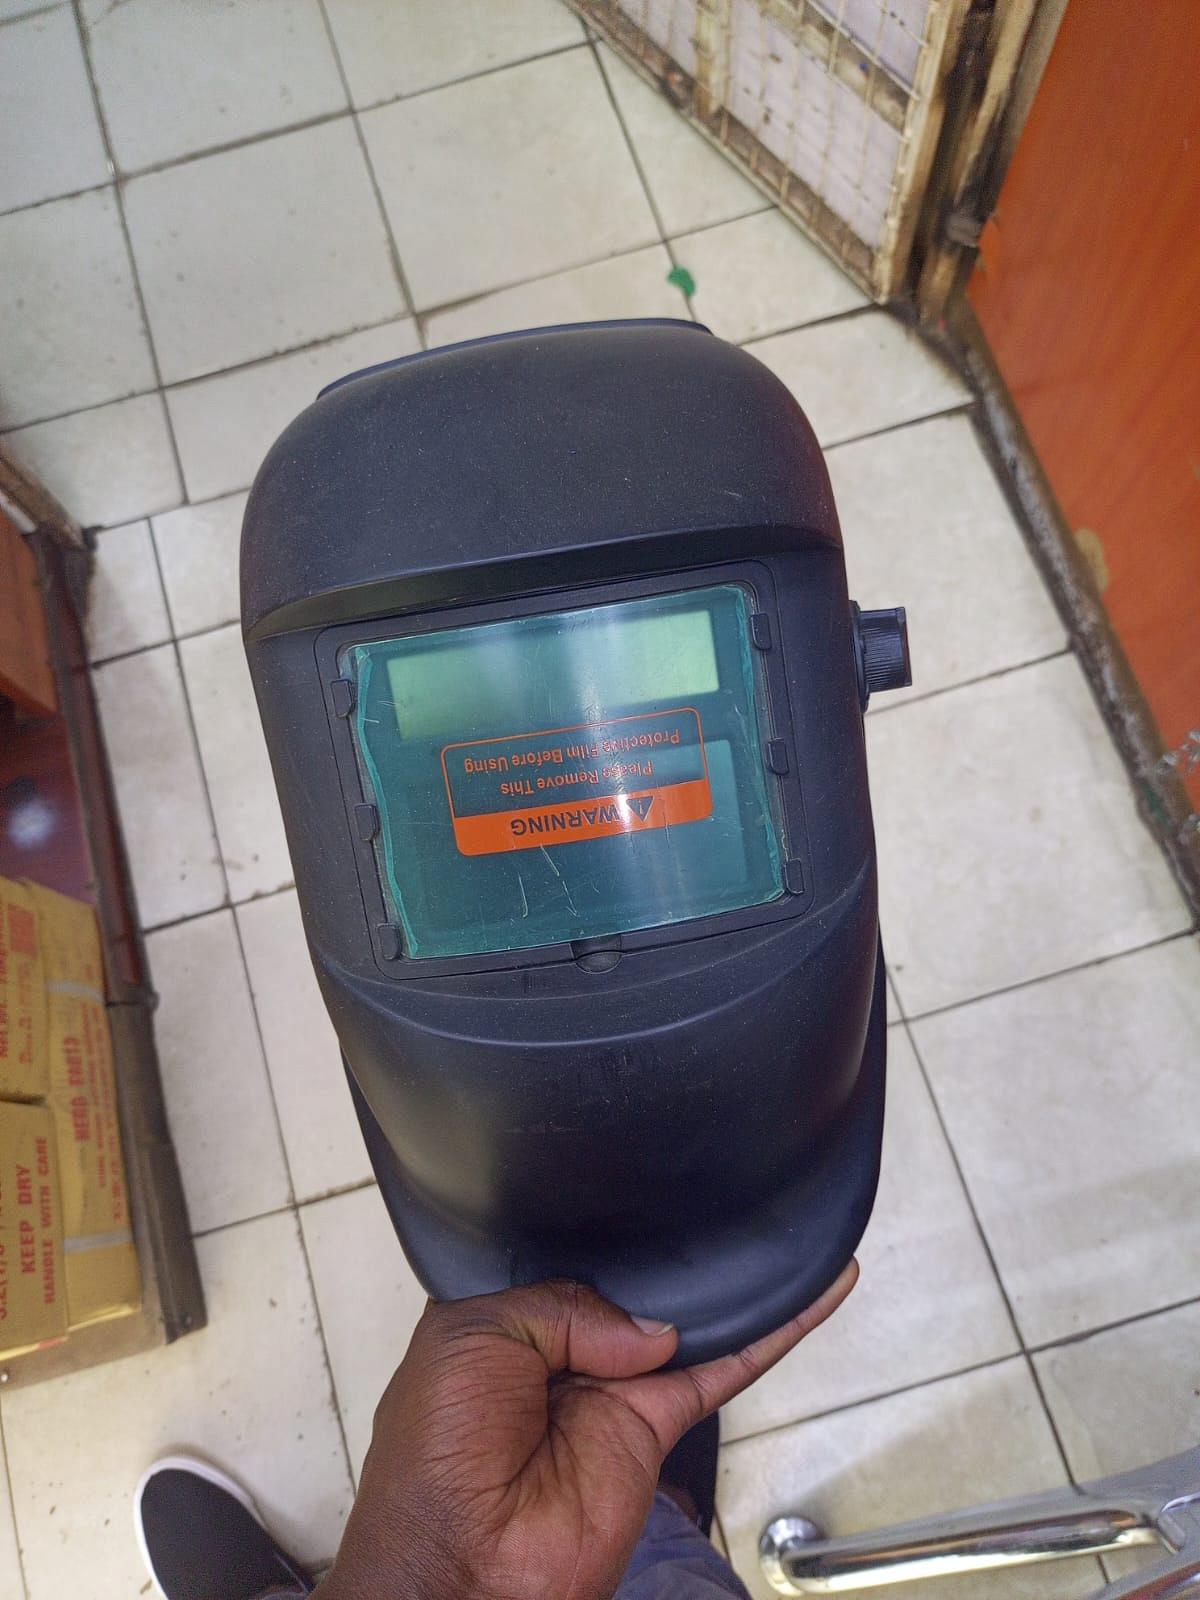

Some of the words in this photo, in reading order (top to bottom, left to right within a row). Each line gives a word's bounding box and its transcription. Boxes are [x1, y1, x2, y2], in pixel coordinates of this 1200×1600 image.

[566, 743, 599, 761] Film
[602, 729, 680, 752] Protective
[464, 755, 508, 774] Using
[512, 748, 563, 769] Before
[602, 760, 653, 778] Please
[500, 779, 532, 796] This
[537, 769, 599, 789] Remove
[510, 804, 622, 835] WARNING
[36, 1136, 49, 1176] CARE
[16, 1163, 33, 1206] DRY
[40, 1185, 52, 1228] WITH
[20, 1219, 36, 1274] KEEP
[43, 1239, 55, 1304] HANDLE
